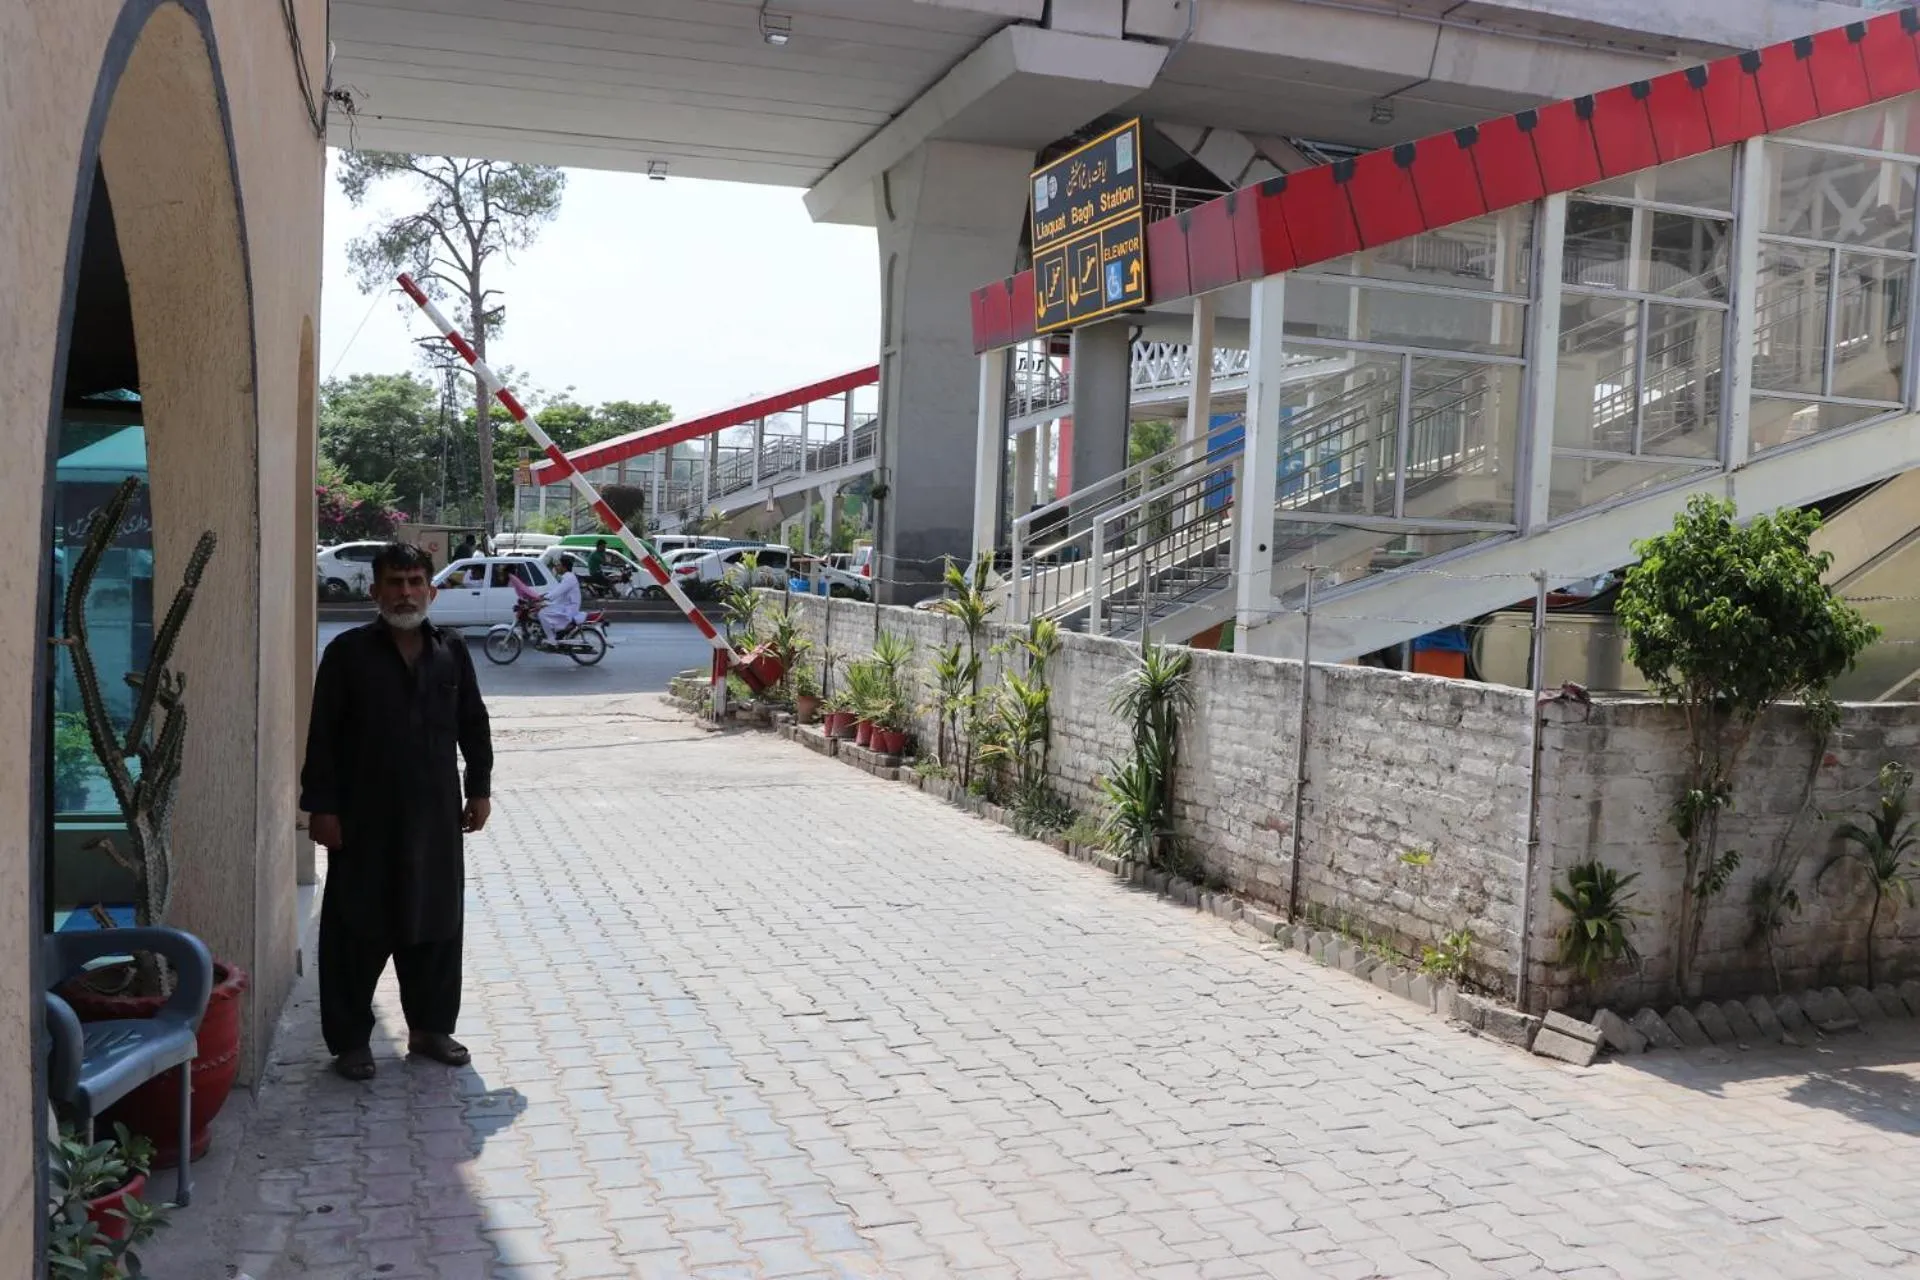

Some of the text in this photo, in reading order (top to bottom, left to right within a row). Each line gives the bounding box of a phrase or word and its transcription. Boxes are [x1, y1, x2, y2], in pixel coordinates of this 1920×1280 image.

[1036, 185, 1135, 240] Liaquat Bagh Station
[1104, 237, 1139, 261] ELEVATOR
